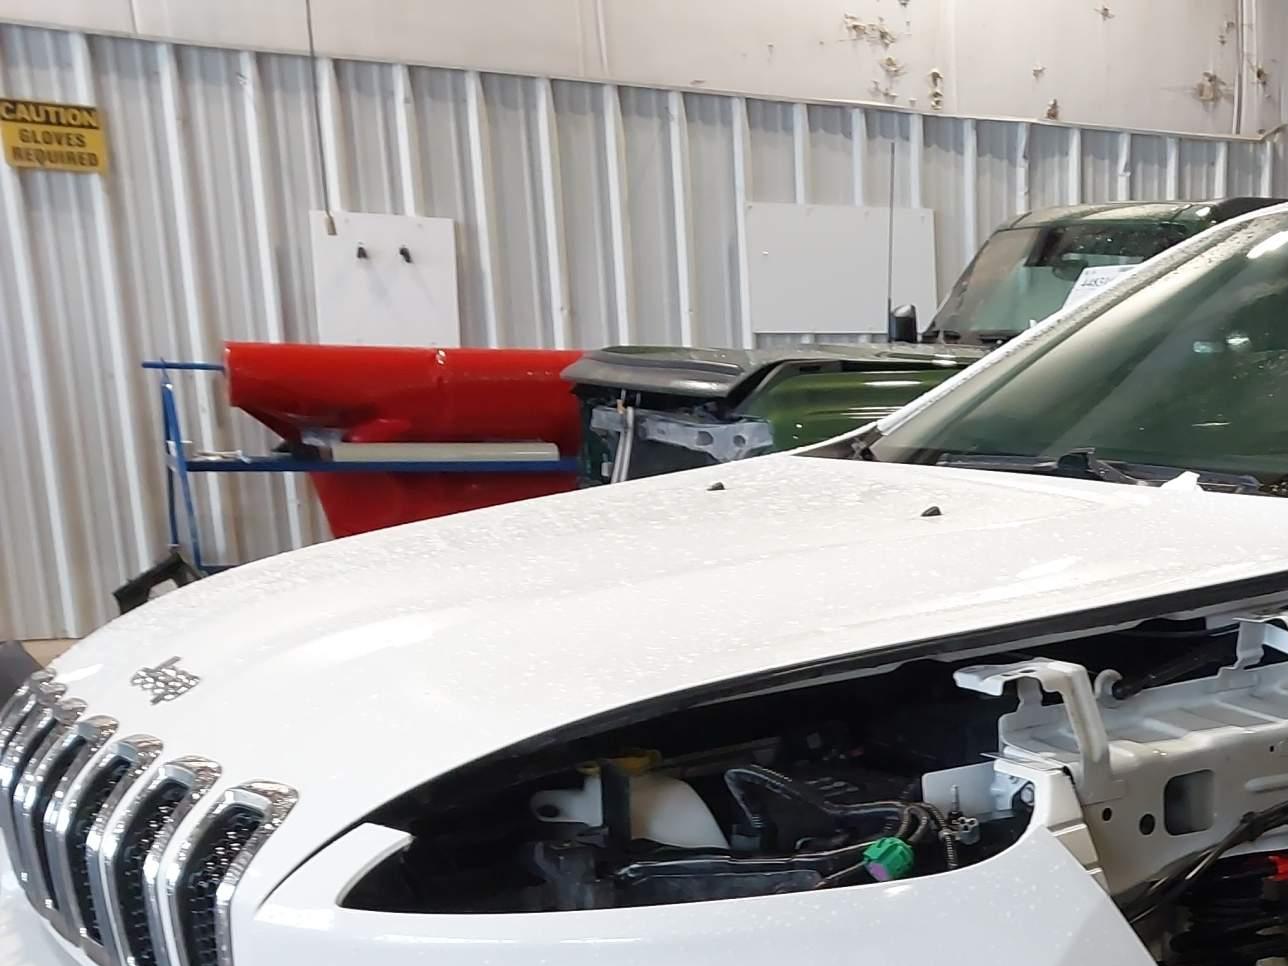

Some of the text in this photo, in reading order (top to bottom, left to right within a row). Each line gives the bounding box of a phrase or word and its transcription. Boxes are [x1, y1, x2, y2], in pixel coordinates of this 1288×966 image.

[0, 101, 97, 127] CAUTION
[18, 127, 87, 148] GLOVES
[12, 145, 99, 168] REQUIRED
